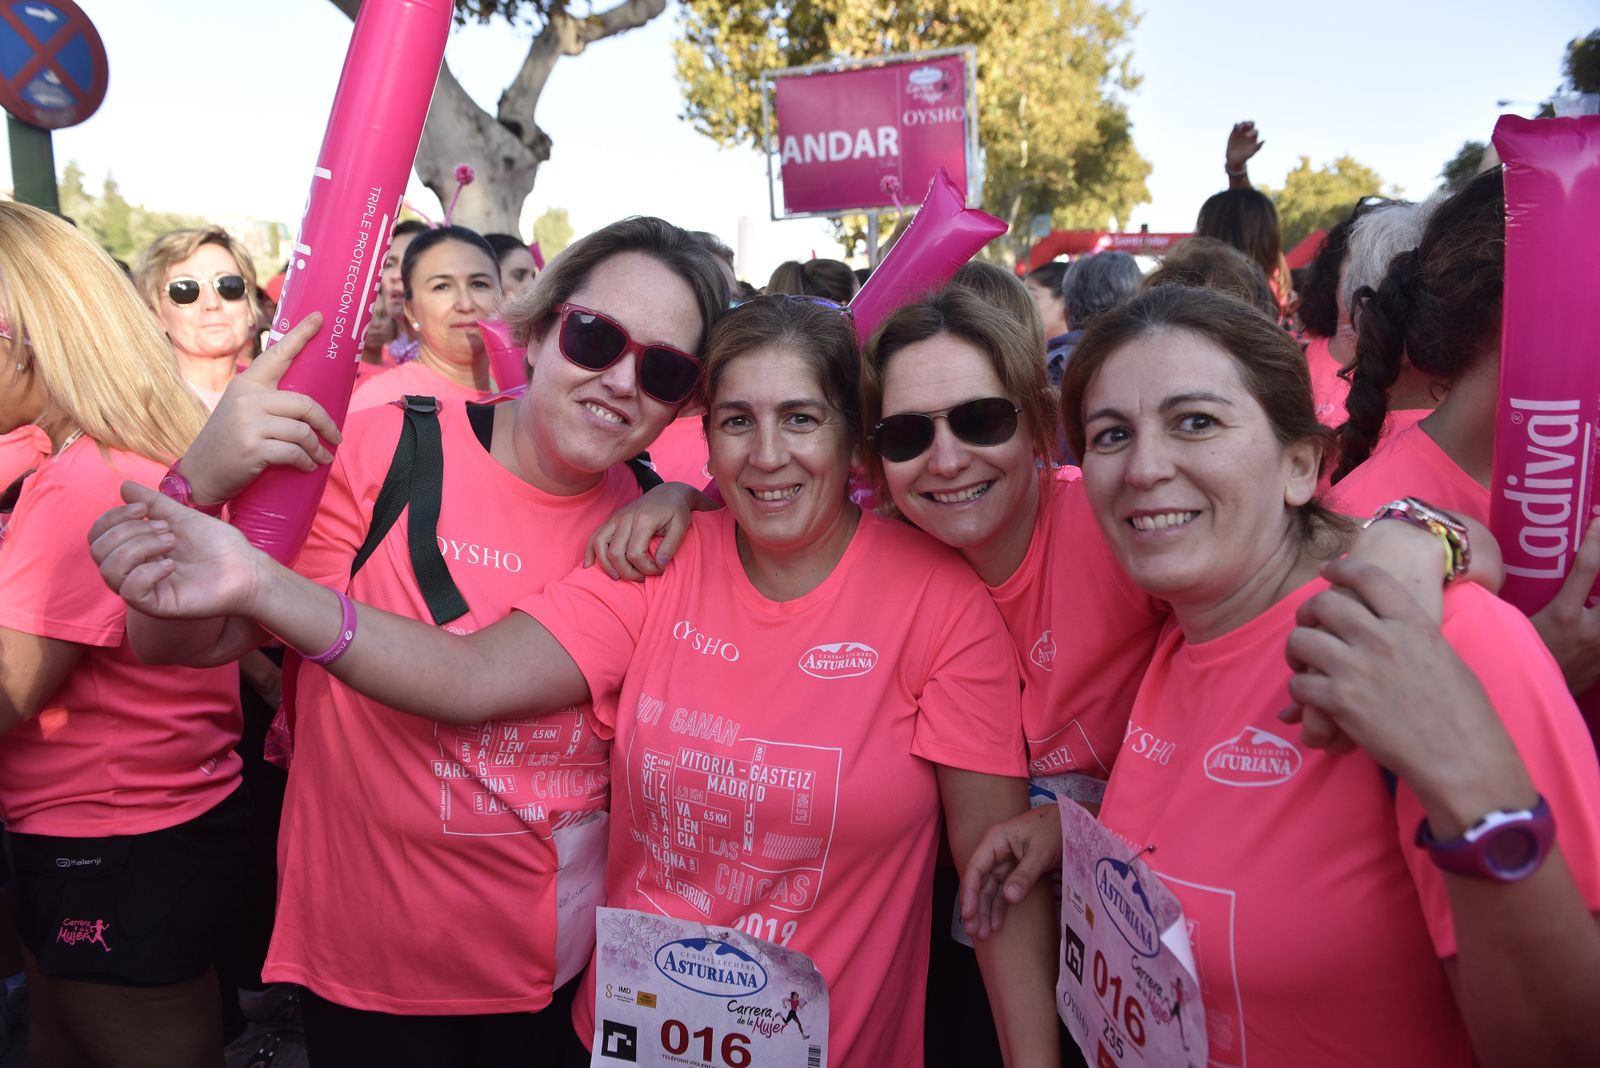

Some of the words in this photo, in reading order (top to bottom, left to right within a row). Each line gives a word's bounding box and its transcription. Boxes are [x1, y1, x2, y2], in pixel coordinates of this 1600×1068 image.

[903, 105, 965, 127] OYSHO
[781, 125, 899, 166] ANDAR
[360, 186, 382, 230] TRIPLE
[338, 231, 369, 314] PROTECCIÓN
[326, 317, 346, 360] SOLAR
[1503, 397, 1581, 579] Ladival
[803, 653, 873, 670] ASTURIANA
[544, 729, 557, 739] KM
[670, 707, 740, 748] GANAN
[1123, 719, 1176, 766] YSHO
[495, 753, 515, 765] CIA
[498, 741, 524, 753] LEN
[528, 751, 560, 767] LAS
[1030, 748, 1072, 773] STEIZ
[681, 750, 735, 777] VITORIA
[750, 764, 812, 790] GASTEIZ
[707, 775, 766, 802] MADRID
[677, 816, 699, 835] LEN
[715, 812, 727, 825] KM
[677, 832, 697, 849] CIA
[709, 836, 739, 861] LAS
[676, 881, 711, 915] CORUÑA
[714, 863, 810, 906] CHICAS
[1099, 867, 1153, 952] ASTURIANA
[662, 950, 758, 988] ASTURIANA
[680, 950, 715, 965] CENTRAL
[717, 960, 755, 972] LECHERA
[1131, 954, 1162, 997] Carrera
[618, 985, 632, 994] IMD
[1093, 949, 1147, 1048] 016
[727, 999, 773, 1018] Carrera
[736, 1016, 746, 1025] de
[746, 1017, 754, 1026] la
[752, 1017, 788, 1038] Mujer
[1103, 1018, 1124, 1059] 235
[660, 1018, 753, 1068] 016
